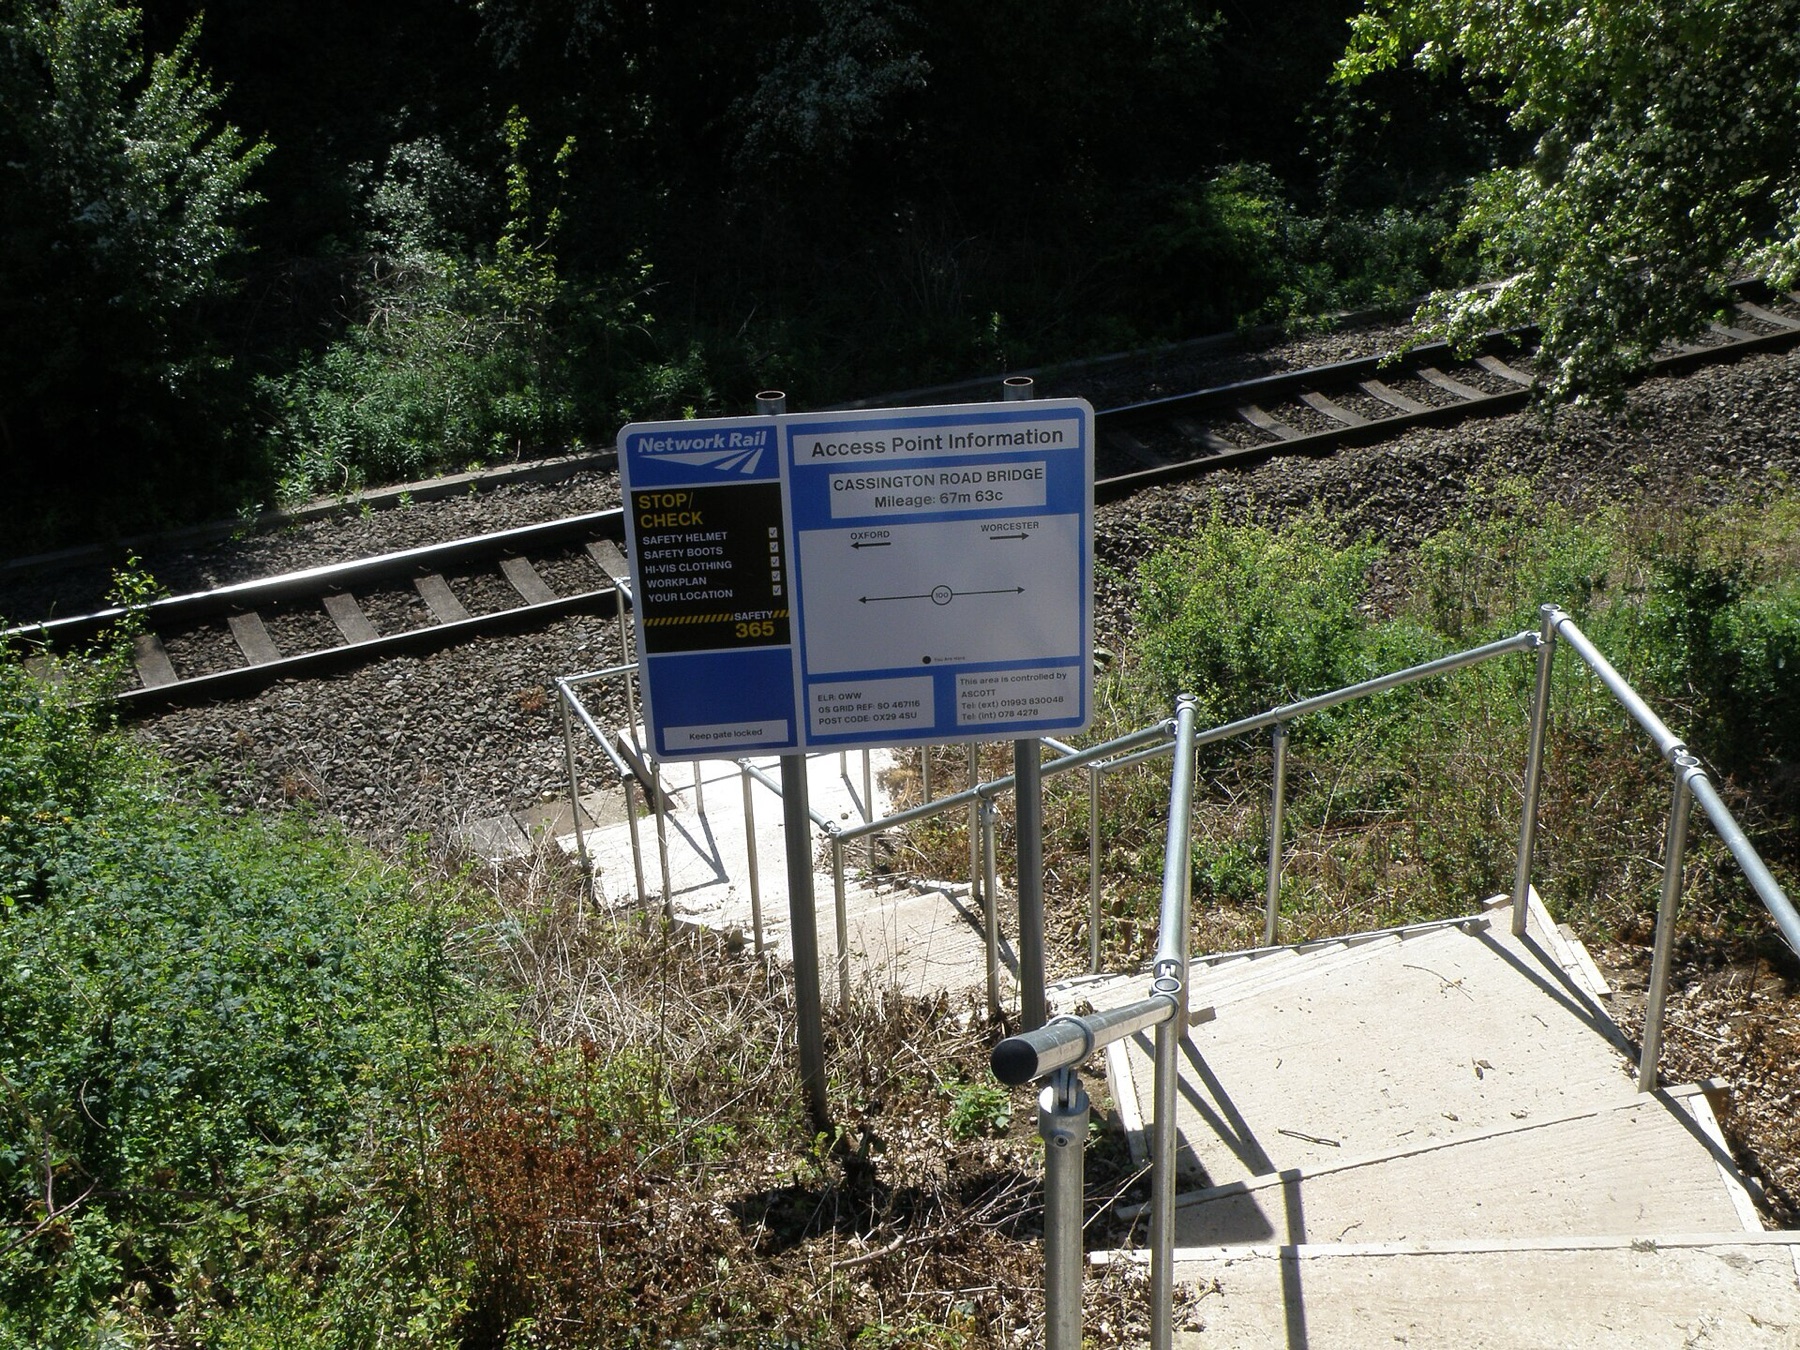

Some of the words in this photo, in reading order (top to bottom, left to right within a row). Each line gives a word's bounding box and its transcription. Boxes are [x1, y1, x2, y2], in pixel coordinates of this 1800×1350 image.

[638, 434, 726, 453] Network
[729, 431, 767, 448] Rail
[812, 440, 886, 458] Access
[892, 434, 943, 453] Point
[949, 428, 1063, 449] Information
[833, 474, 935, 491] CASSINGTON
[940, 471, 983, 485] ROAD
[986, 468, 1043, 482] BRIDGE
[638, 491, 694, 510] STOP/
[874, 495, 936, 508] Mileage:
[940, 492, 971, 504] 67m
[975, 490, 1003, 502] 63c
[640, 511, 704, 529] CHECK
[981, 521, 1039, 532] WORCESTER
[642, 534, 683, 545] SAFETY
[685, 531, 728, 543] HELMET
[850, 530, 890, 540] OXFORD
[644, 549, 684, 560] SAFETY
[687, 546, 724, 557] BOOTS
[645, 563, 677, 574] HI-VIS
[679, 560, 733, 572] CLOTHING
[646, 576, 707, 588] WORKPLAN
[648, 592, 678, 603] YOUR
[680, 589, 733, 601] LOCATION
[734, 610, 773, 621] SAFETY
[735, 621, 775, 638] 365
[960, 678, 978, 686] This
[1010, 672, 1054, 683] controlled
[1056, 672, 1067, 680] by
[838, 692, 862, 700] OWW
[961, 689, 995, 698] ASCOTT
[833, 705, 854, 713] GRID
[856, 703, 875, 711] REF:
[877, 702, 890, 710] SO
[978, 700, 999, 710] (ext)
[1000, 698, 1027, 707] 01993
[818, 717, 841, 725] POST
[844, 715, 871, 723] CODE:
[873, 713, 896, 722] OX29
[978, 711, 997, 721] (int)
[998, 710, 1015, 718] 078
[1016, 708, 1039, 716] 4278
[713, 731, 732, 740] gate
[734, 728, 763, 736] locked
